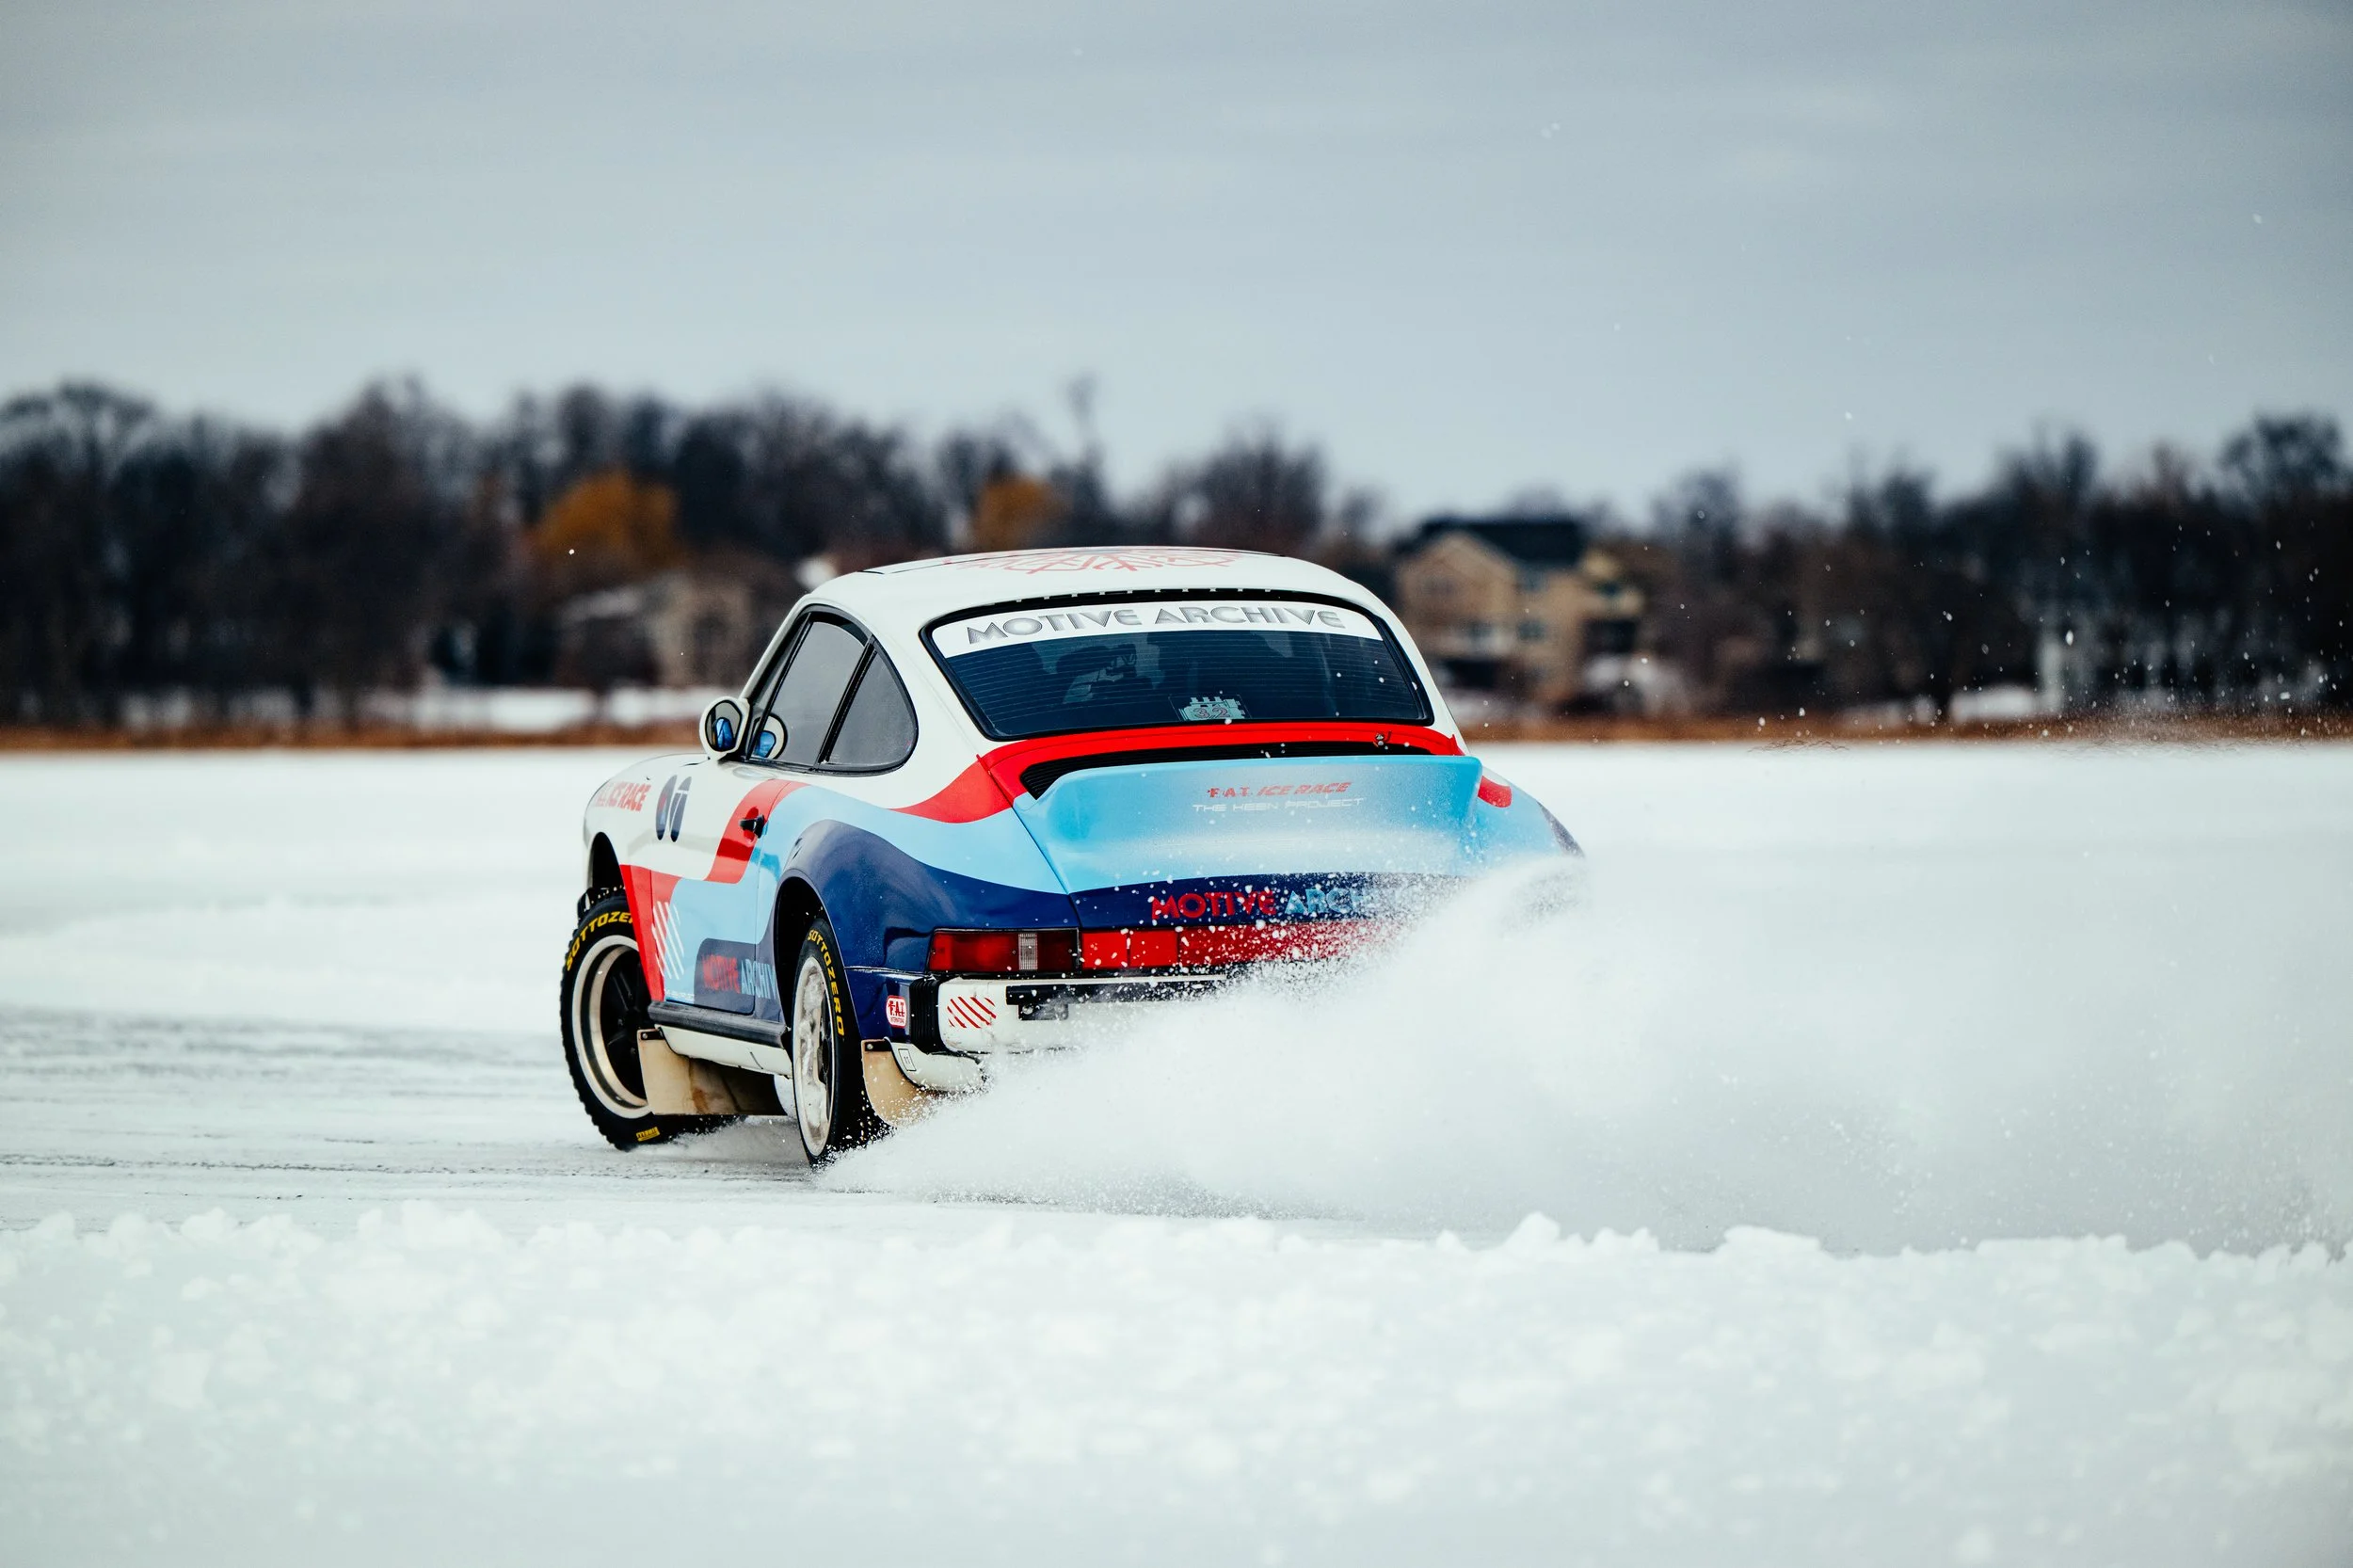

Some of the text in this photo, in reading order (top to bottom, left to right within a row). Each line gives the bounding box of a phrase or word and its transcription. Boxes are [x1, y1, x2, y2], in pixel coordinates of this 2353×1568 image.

[967, 606, 1346, 645] MOTIVE ARCHIVE
[1192, 803, 1227, 813] THE
[1284, 798, 1365, 810] PROJECT
[1257, 784, 1293, 796] ICE
[1293, 782, 1353, 795] RACE
[1151, 887, 1395, 920] MOTIVE ARCH
[807, 929, 845, 1036] SOTTOZERO
